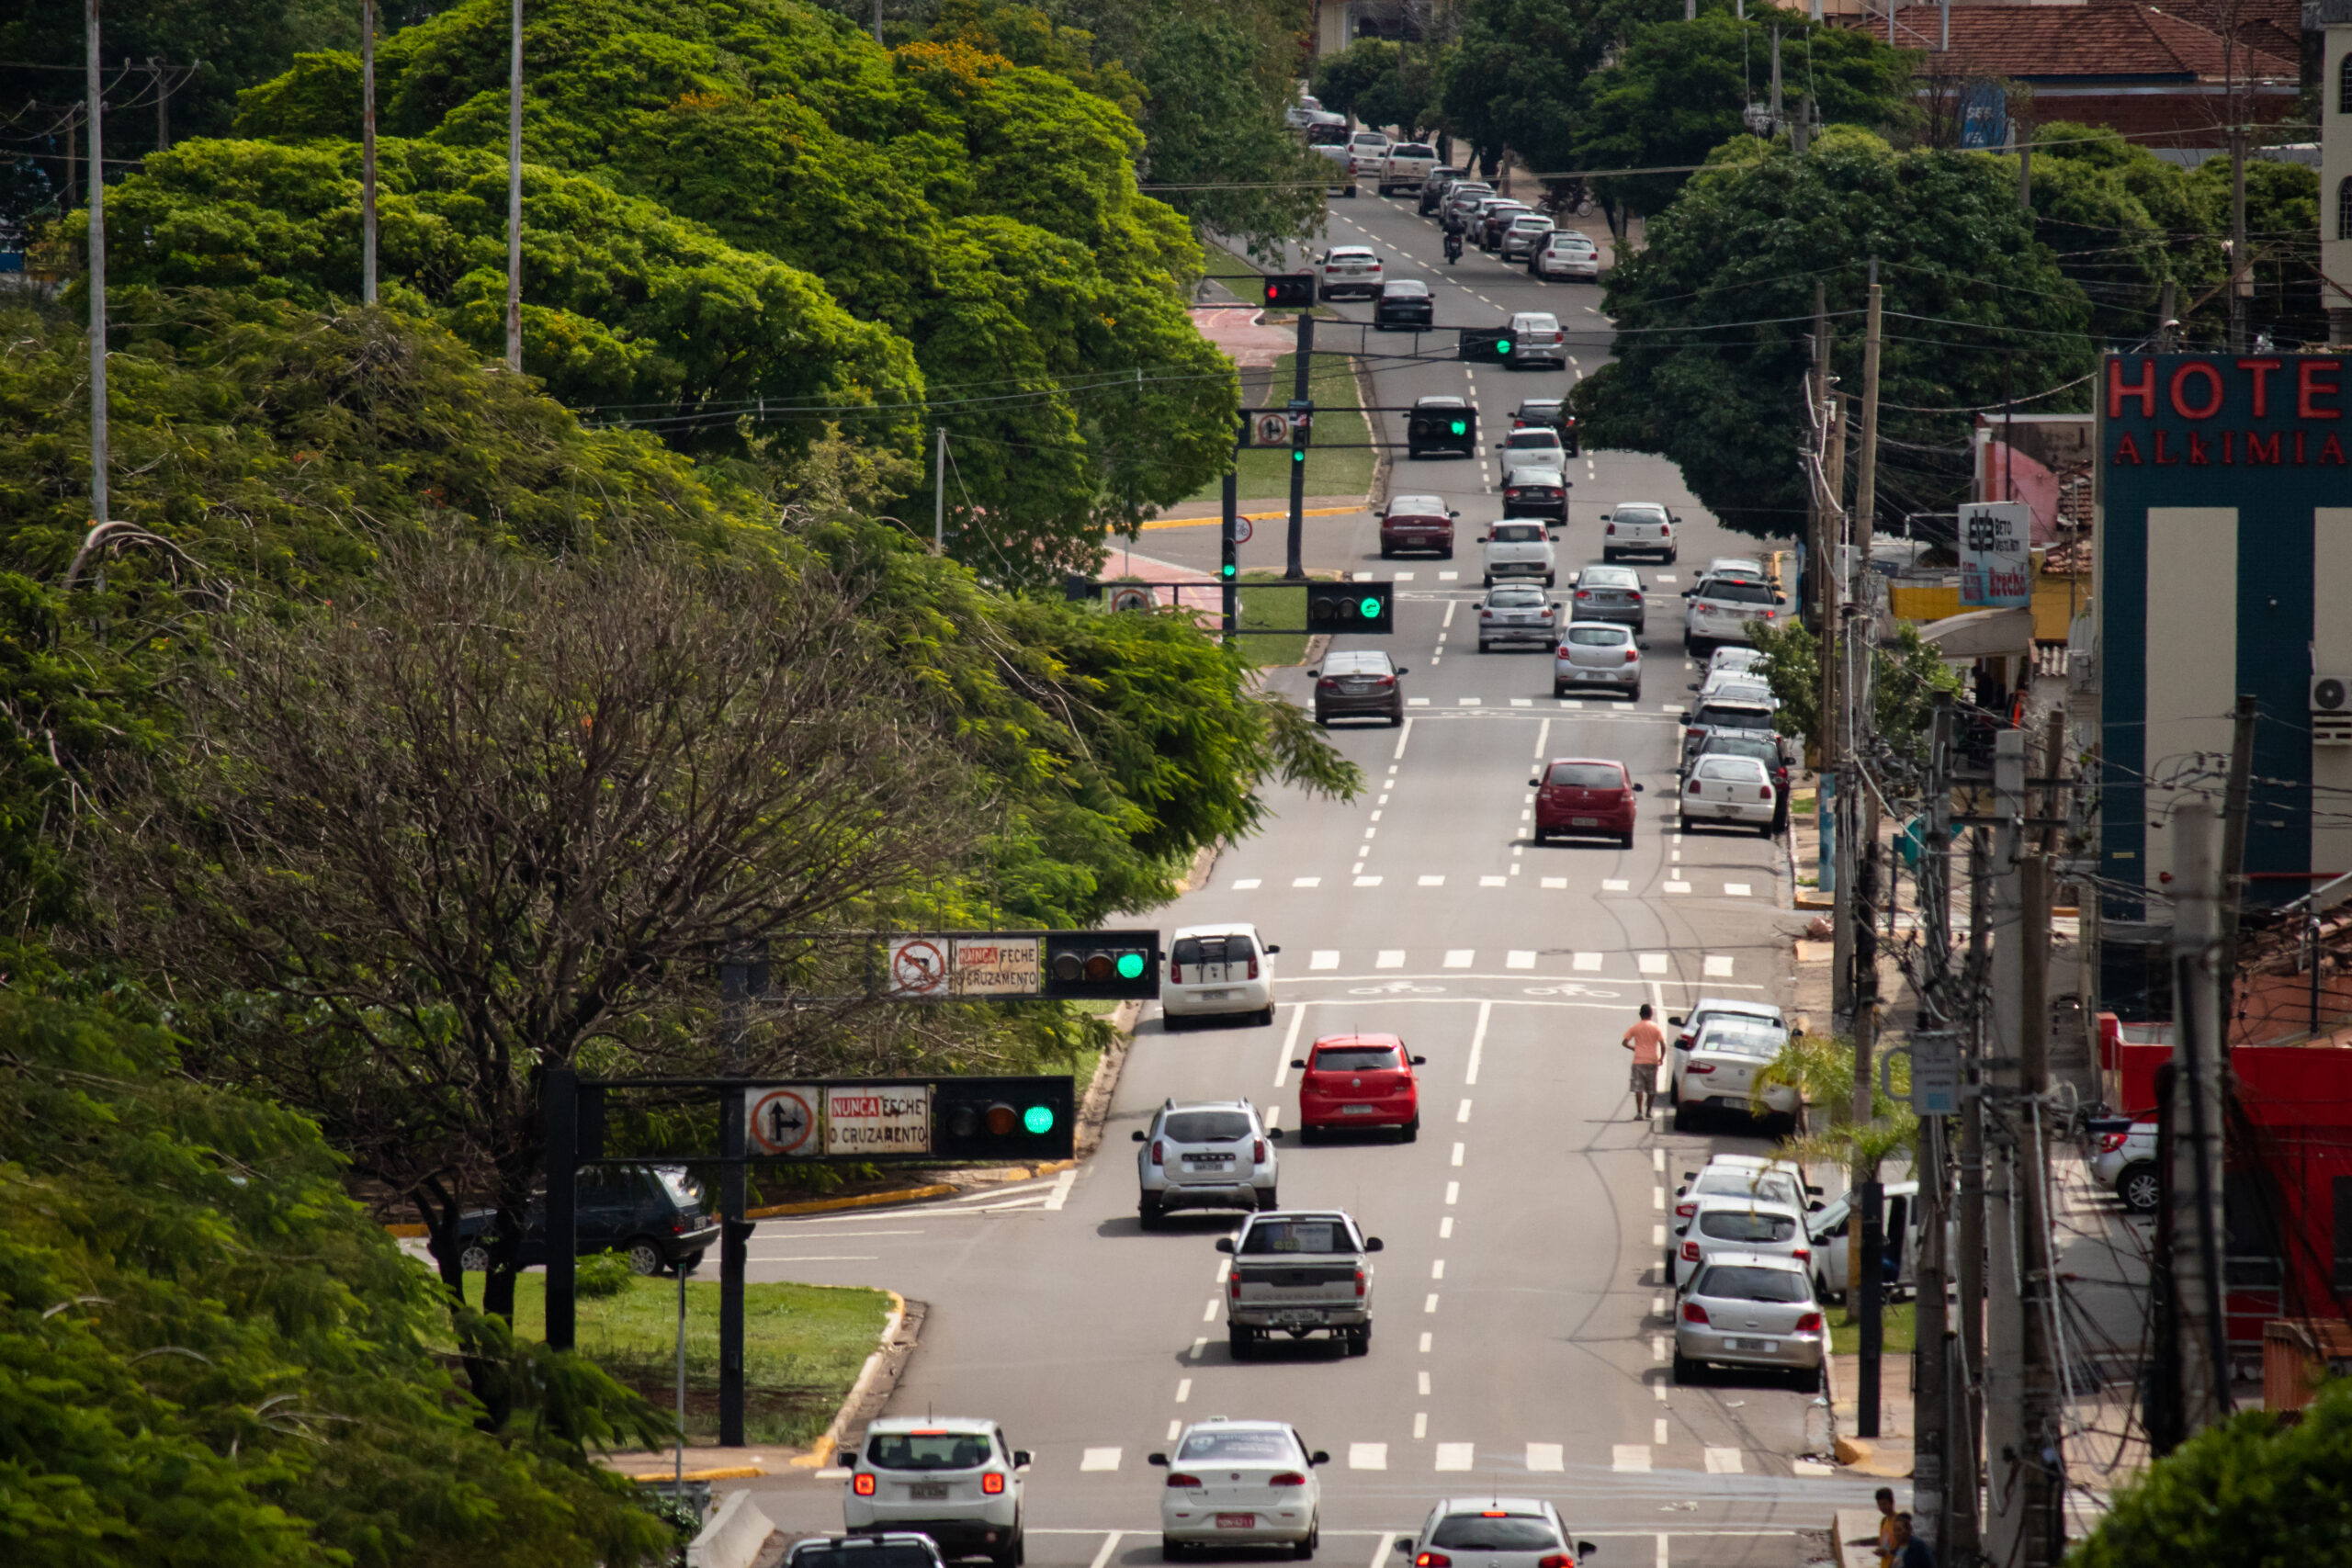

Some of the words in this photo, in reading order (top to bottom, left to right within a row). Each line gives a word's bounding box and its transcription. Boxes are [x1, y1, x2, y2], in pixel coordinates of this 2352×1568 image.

[1001, 948, 1035, 963] FECHE
[832, 1098, 878, 1116] NUNCA
[830, 1128, 838, 1144] O
[842, 1127, 927, 1144] CRUZAMENTO
